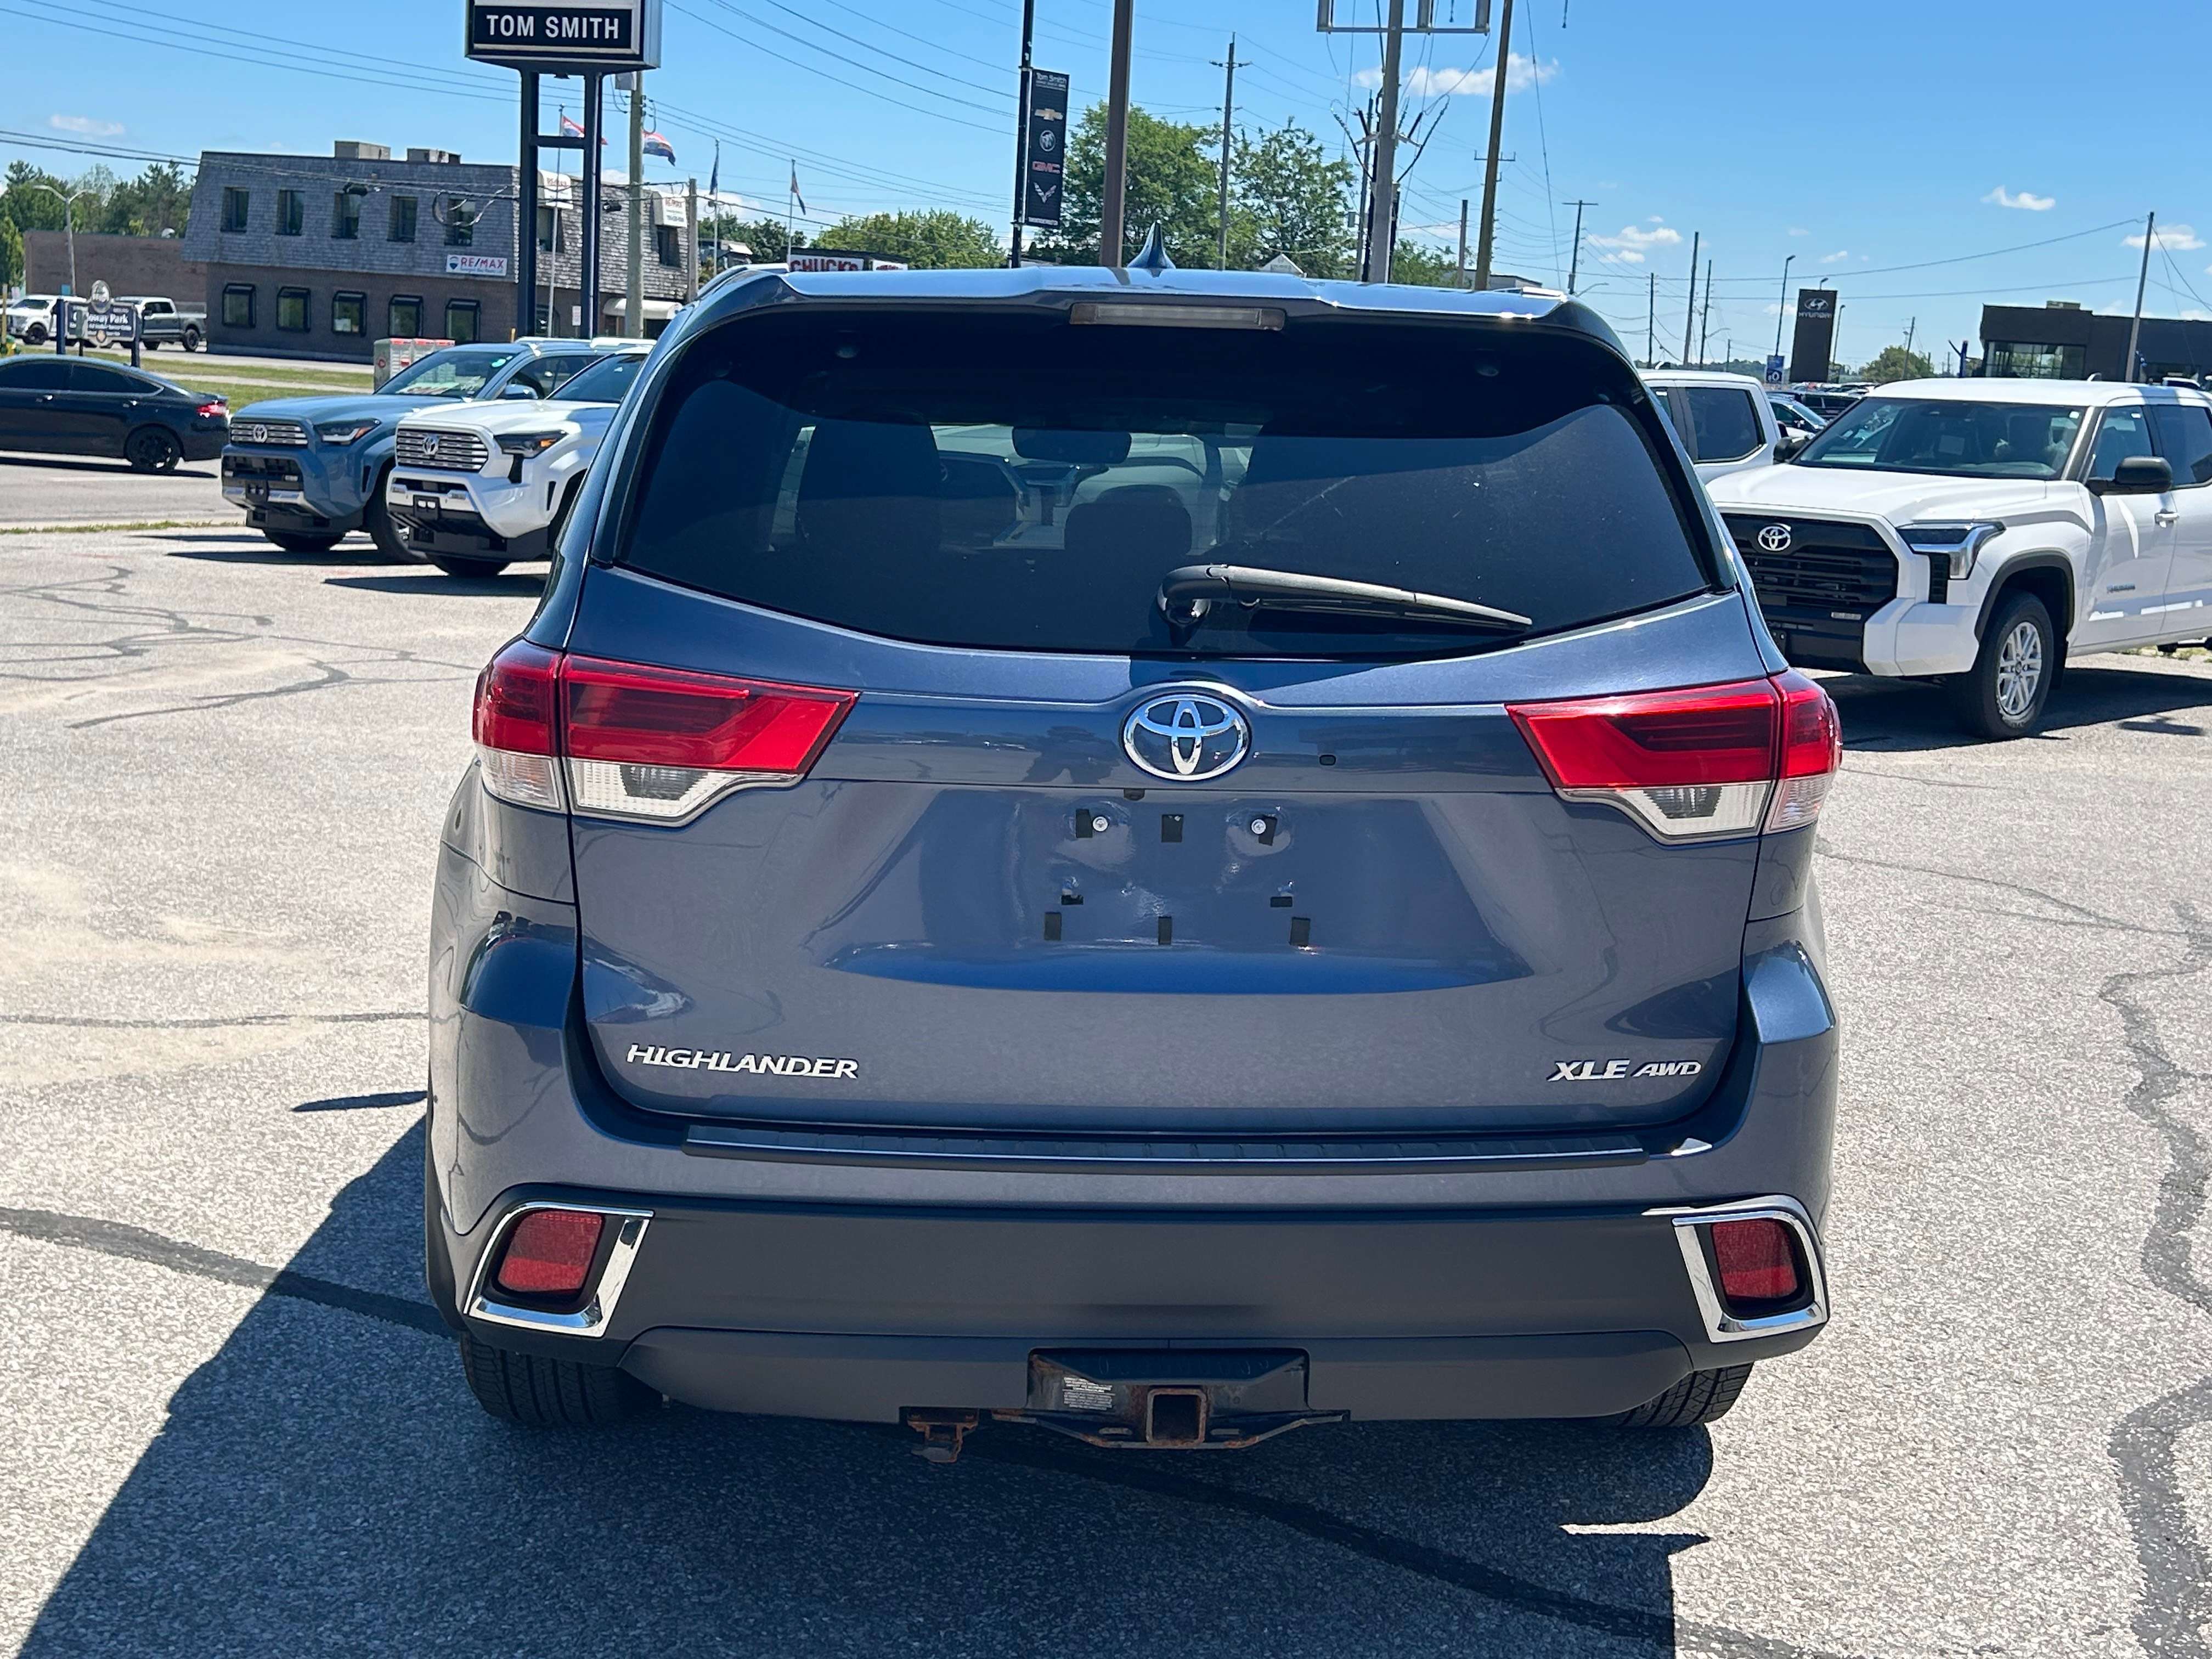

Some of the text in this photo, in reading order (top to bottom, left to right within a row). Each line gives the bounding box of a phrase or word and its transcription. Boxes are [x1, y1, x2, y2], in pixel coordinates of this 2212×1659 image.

[486, 15, 619, 39] TOM SMITH
[1036, 72, 1048, 81] Tom
[1032, 161, 1060, 173] GMC
[461, 257, 504, 268] RE/MAX
[627, 1043, 859, 1079] HIGHLANDER
[1546, 1059, 1702, 1081] XLE AWD
